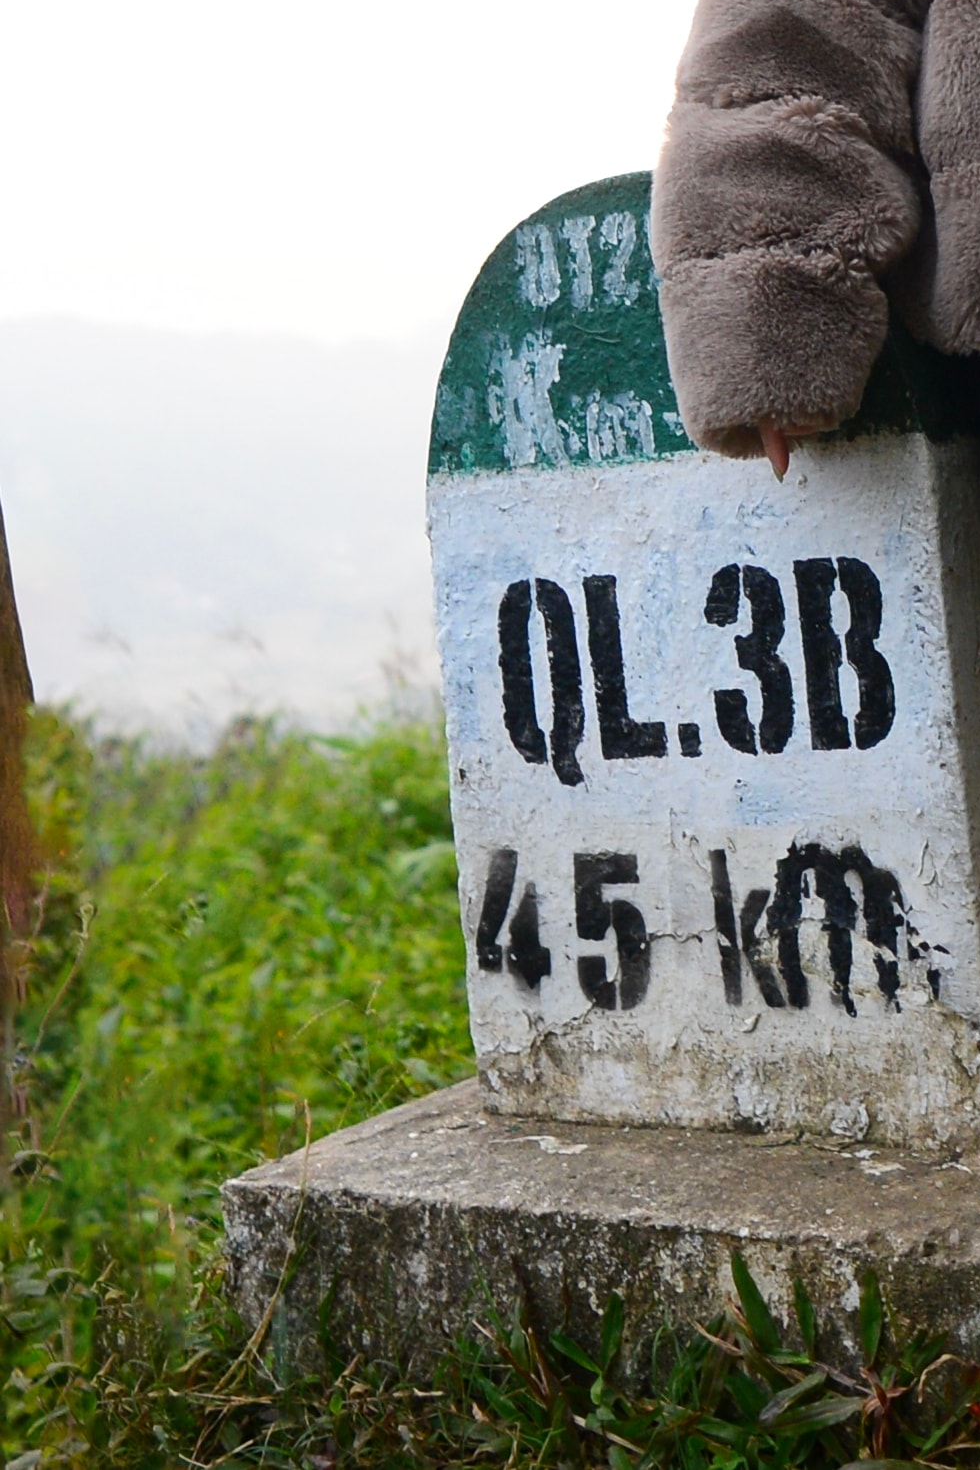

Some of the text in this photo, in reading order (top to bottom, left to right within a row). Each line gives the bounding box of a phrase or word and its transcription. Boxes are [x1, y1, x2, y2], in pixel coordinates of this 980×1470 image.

[497, 556, 897, 787] QL.3B
[476, 848, 651, 1011] 45
[708, 840, 945, 1018] km
